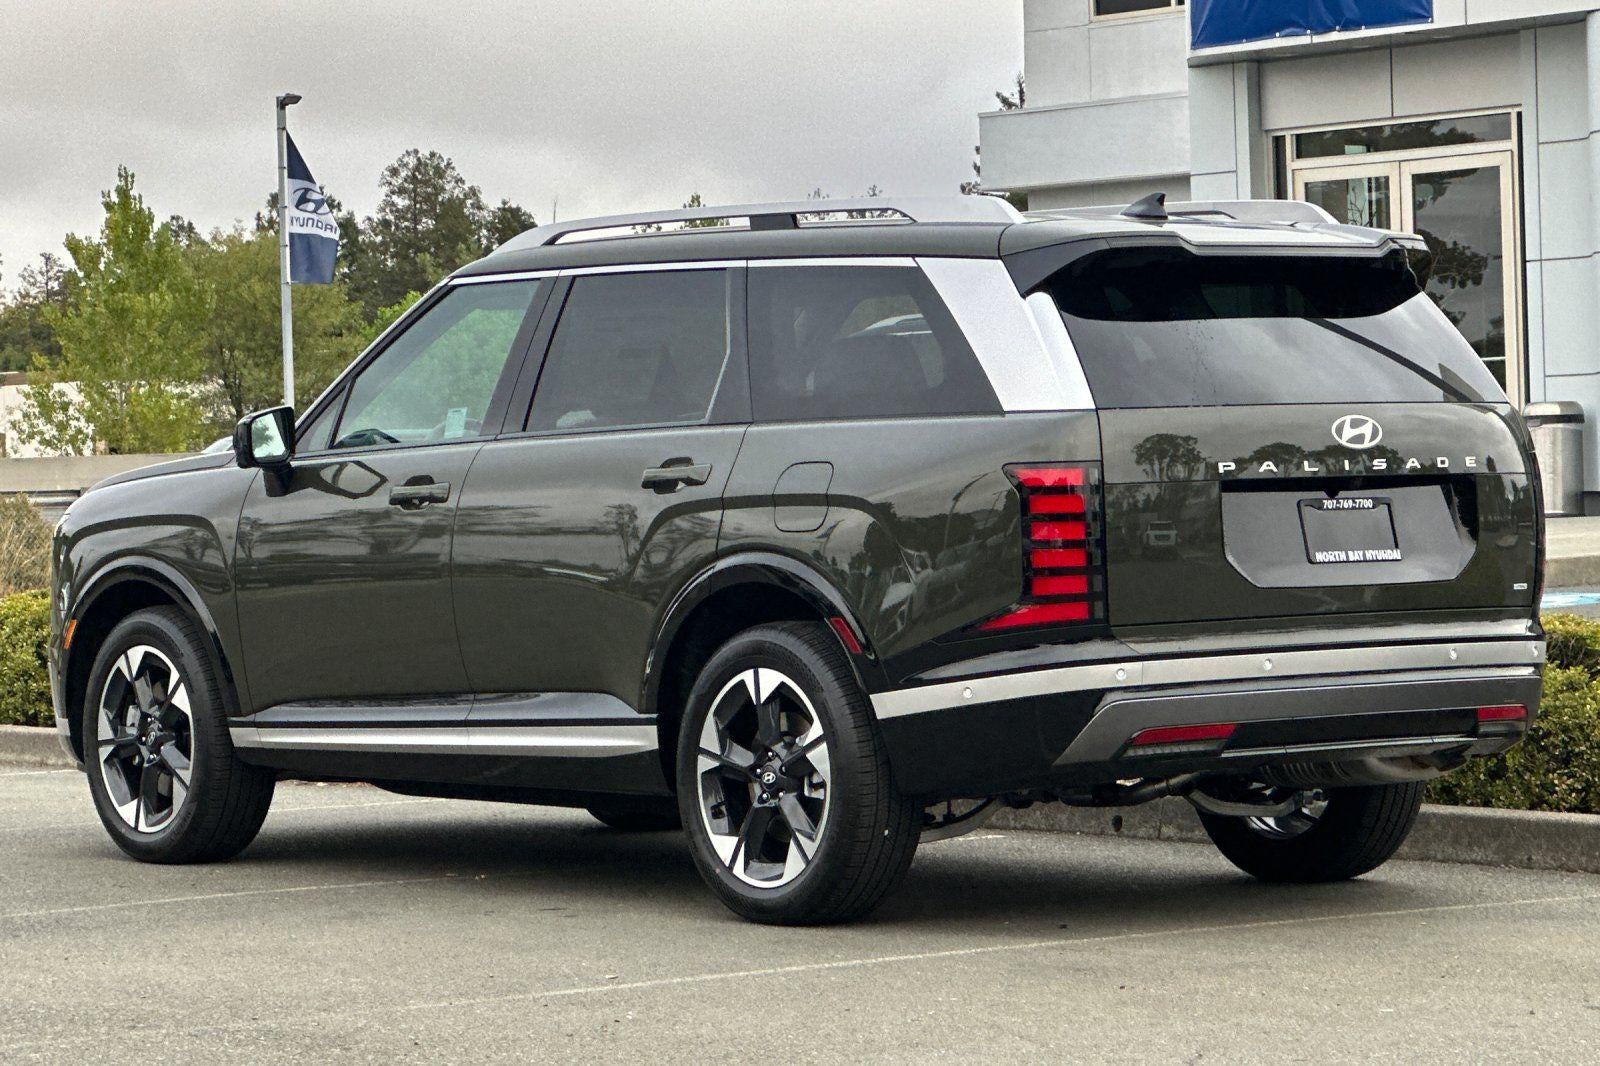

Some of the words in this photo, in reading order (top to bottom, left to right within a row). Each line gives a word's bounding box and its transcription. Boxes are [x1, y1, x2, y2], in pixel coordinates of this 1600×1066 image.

[1217, 456, 1477, 474] PALISADE
[1322, 499, 1373, 509] 707-769-7700
[1315, 551, 1347, 562] NORTH
[1347, 550, 1364, 561] BAY
[1364, 549, 1402, 561] HYUNDAI
